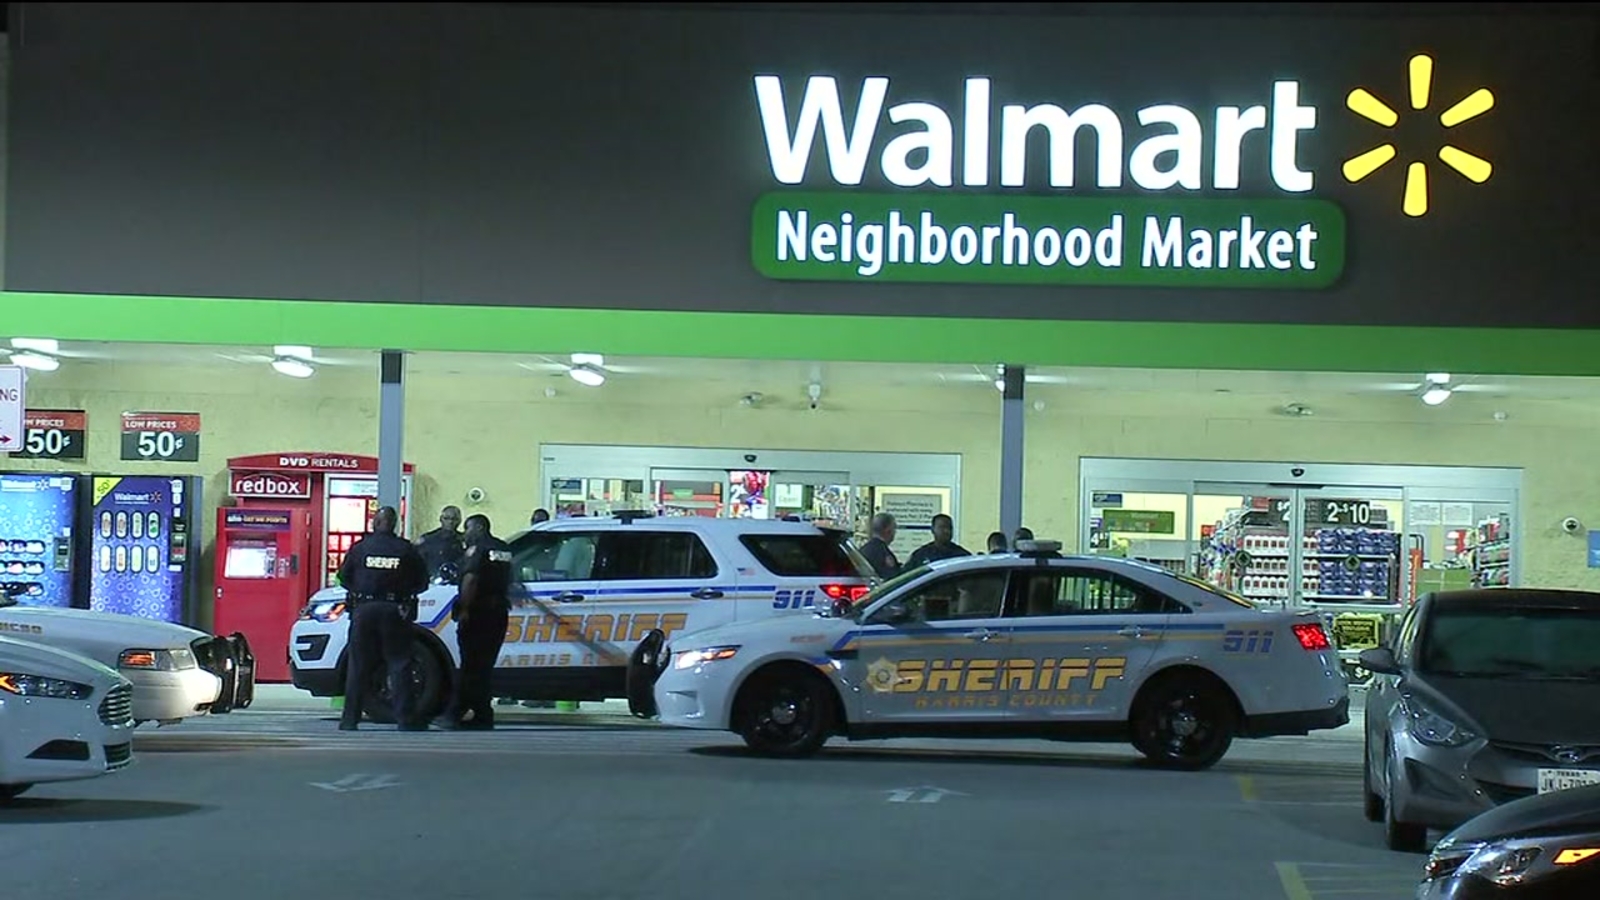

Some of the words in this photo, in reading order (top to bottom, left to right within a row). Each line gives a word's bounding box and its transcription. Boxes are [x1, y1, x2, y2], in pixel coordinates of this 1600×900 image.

[753, 76, 1317, 192] Walmart
[775, 210, 1122, 276] Neighborhood
[1141, 216, 1319, 271] Market
[138, 431, 184, 457] 50¢
[279, 457, 309, 467] DVD
[311, 457, 359, 468] RENTALS
[235, 477, 300, 494] redbox
[366, 555, 400, 570] SHERIFF
[773, 590, 816, 609] 911
[505, 613, 688, 643] SHERIFF
[502, 653, 571, 666] ARRIS
[893, 657, 1127, 693] SHERIFF
